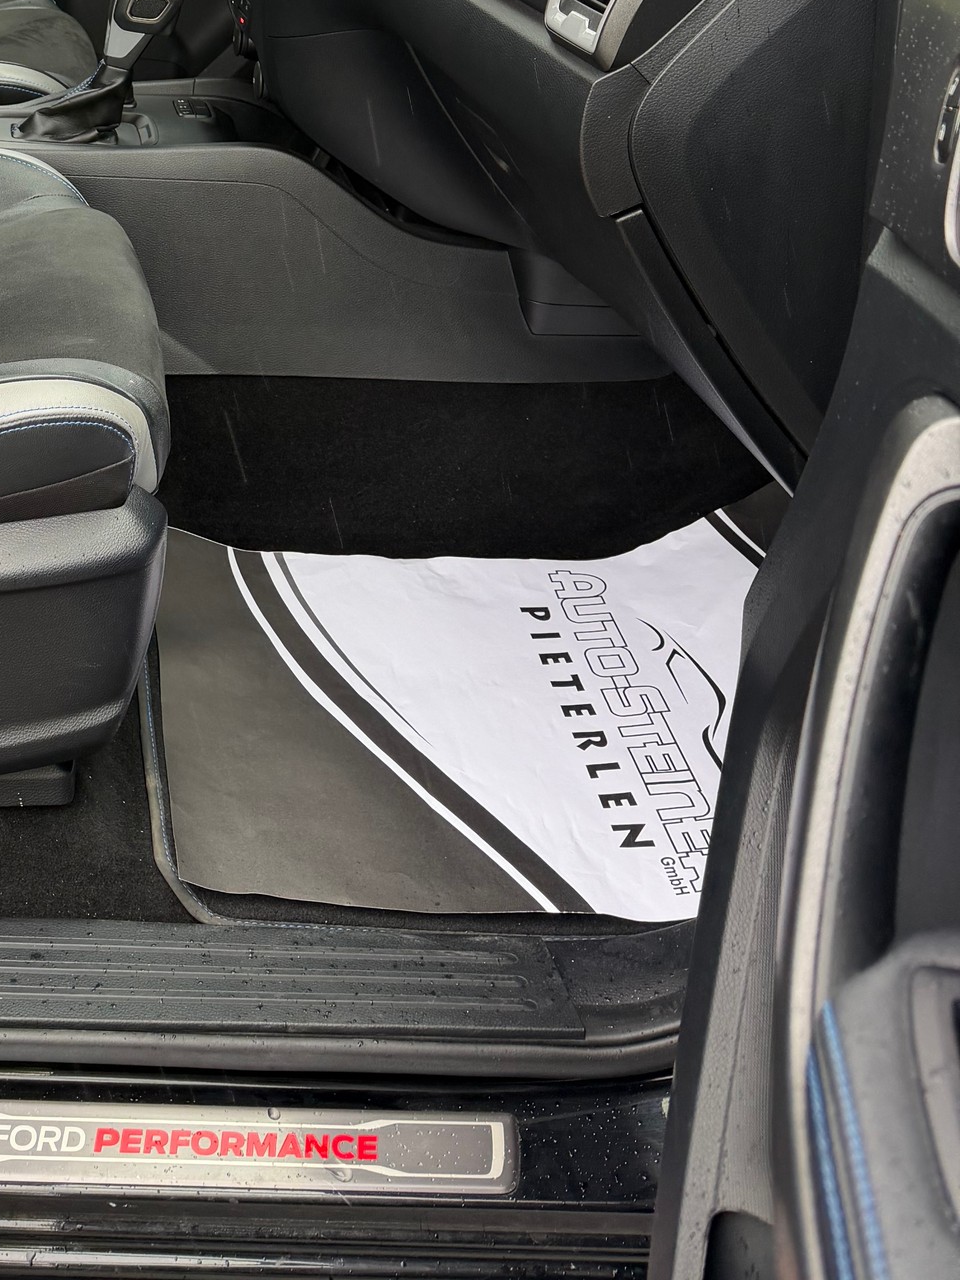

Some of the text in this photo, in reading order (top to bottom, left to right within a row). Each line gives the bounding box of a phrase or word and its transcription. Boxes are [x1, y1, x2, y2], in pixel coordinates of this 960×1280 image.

[520, 607, 656, 848] PIETERLEN
[660, 856, 690, 896] GmbH
[93, 1127, 379, 1161] PERFORMANCE
